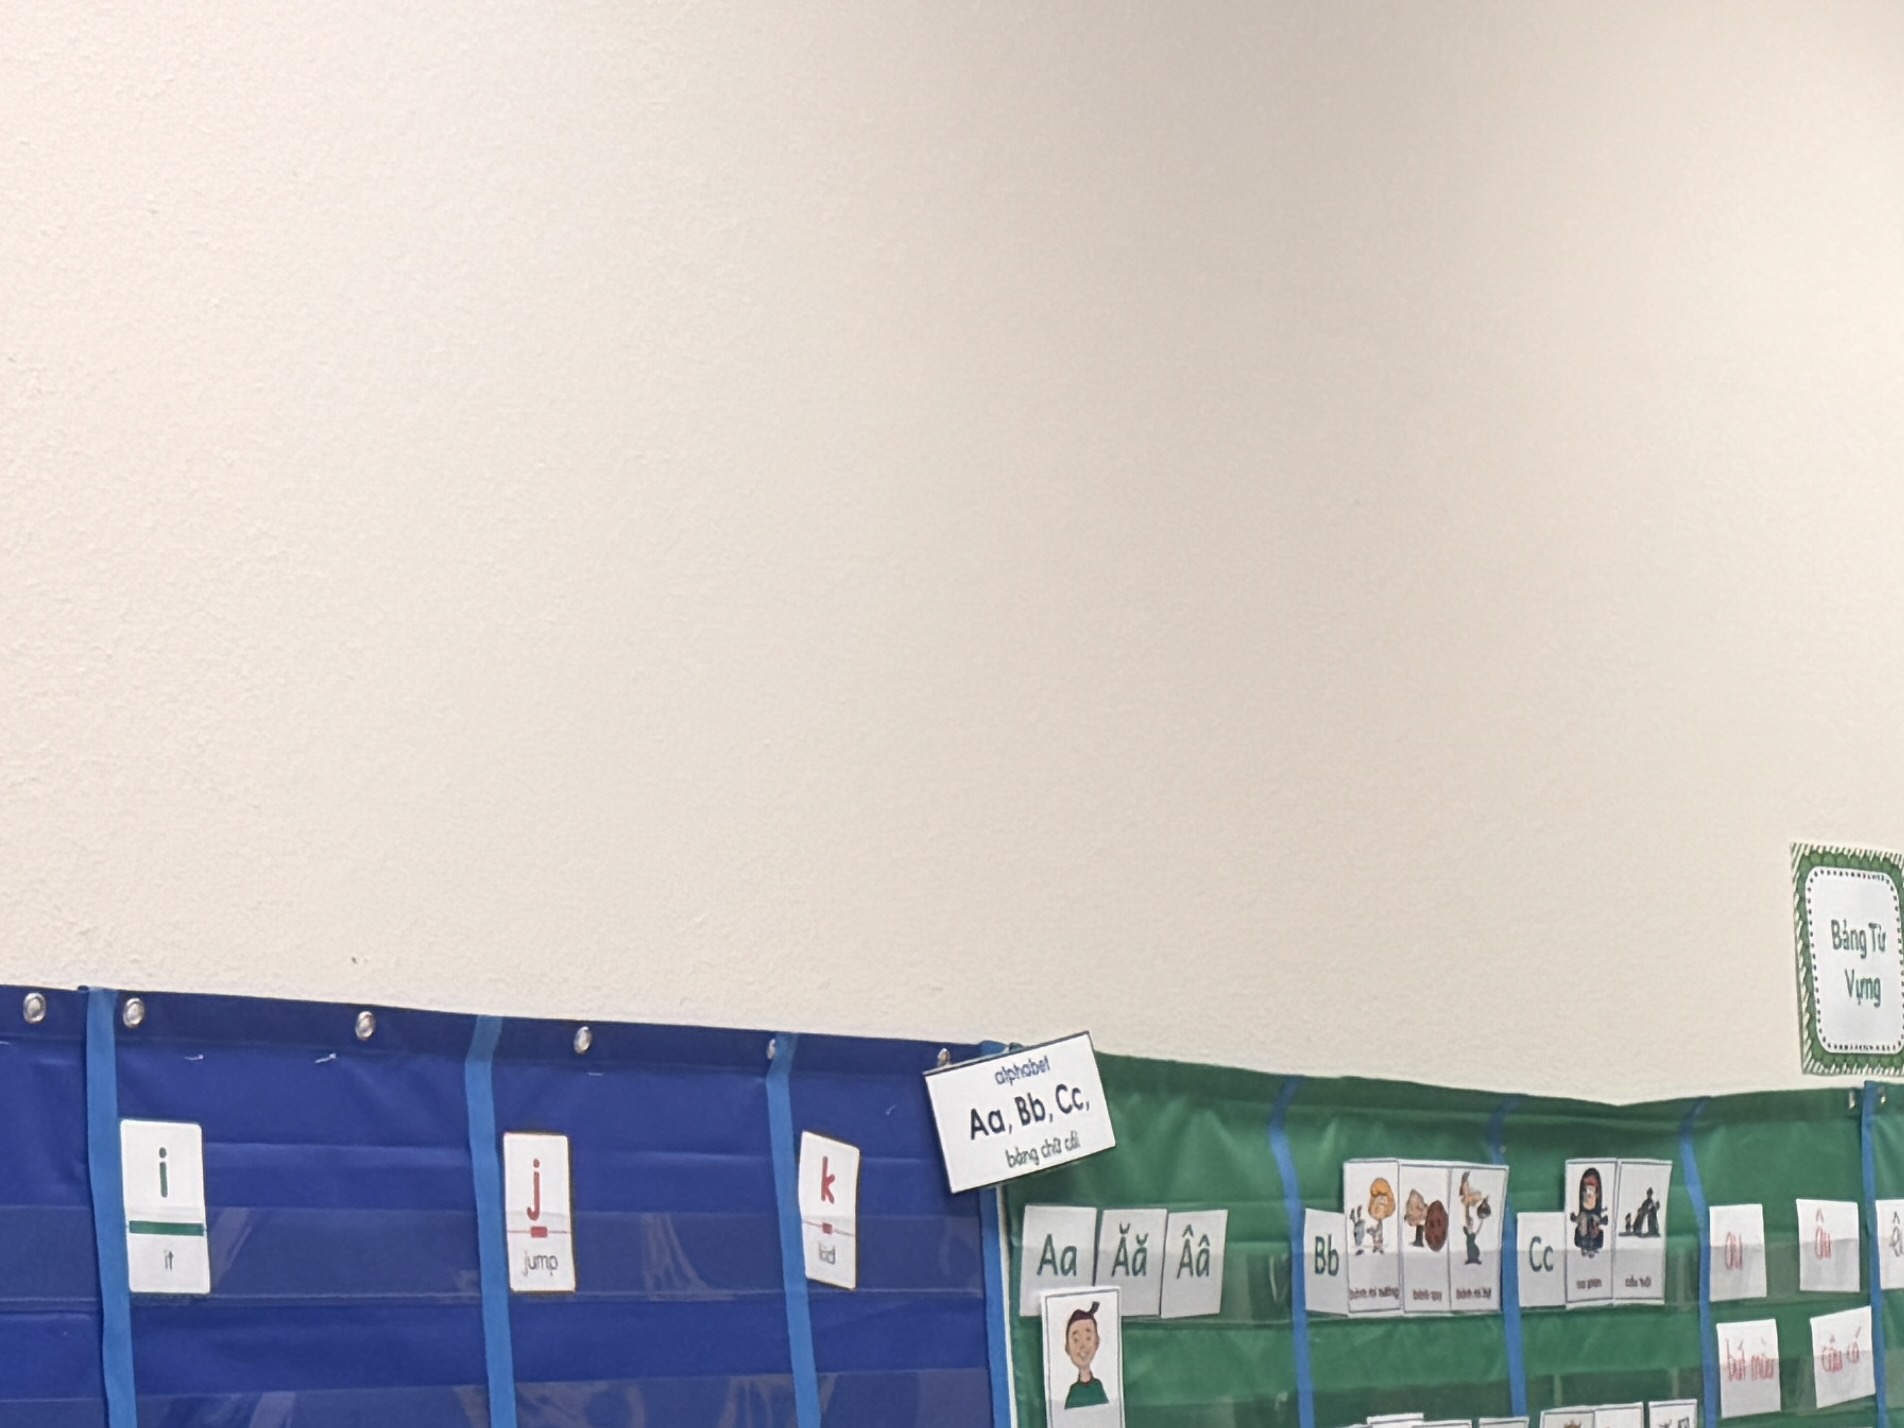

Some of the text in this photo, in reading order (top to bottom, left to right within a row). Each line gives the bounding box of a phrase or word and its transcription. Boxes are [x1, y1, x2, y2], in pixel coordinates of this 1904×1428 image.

[1830, 919, 1867, 960] Bảng
[995, 1055, 1050, 1085] alphabet
[970, 1084, 1089, 1140] Aa, Bb, Cc,
[159, 1147, 168, 1198] i
[527, 1159, 541, 1221] j
[820, 1156, 836, 1204] k
[521, 1251, 559, 1277] jump
[1037, 1223, 1210, 1279] Aa Ăă Ââ
[1314, 1236, 1340, 1276] Bb
[1529, 1237, 1554, 1273] Cc
